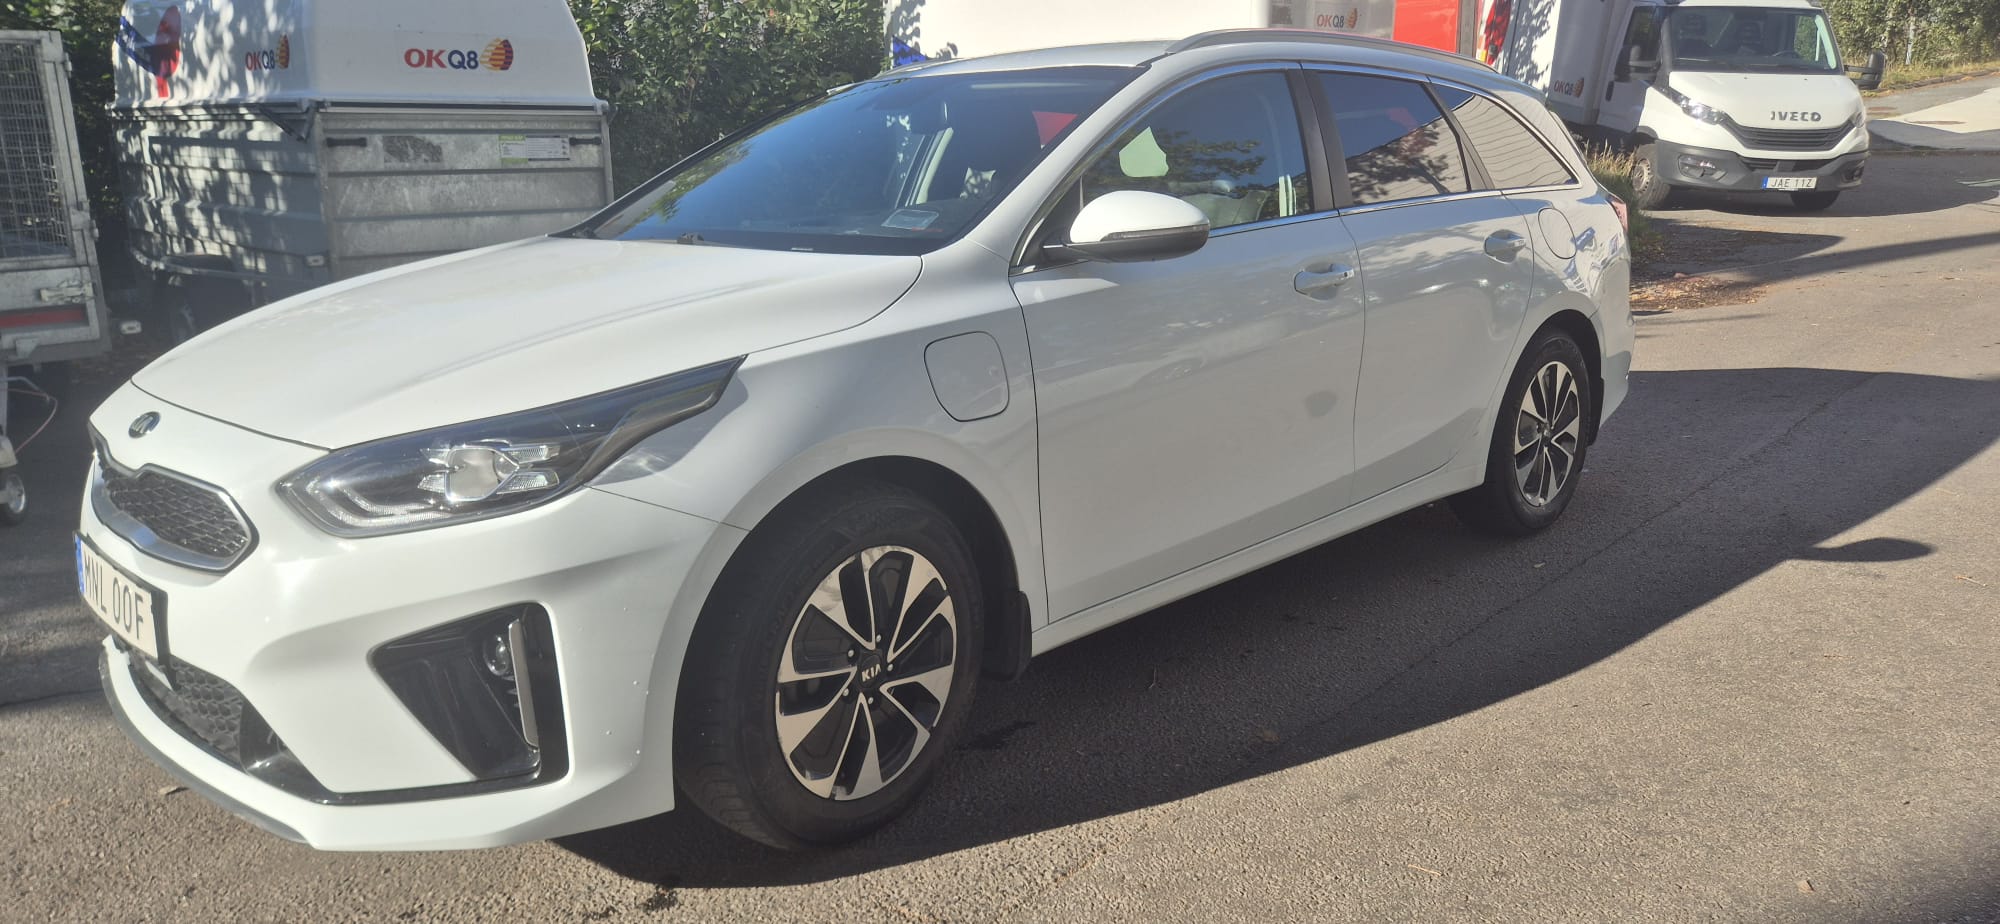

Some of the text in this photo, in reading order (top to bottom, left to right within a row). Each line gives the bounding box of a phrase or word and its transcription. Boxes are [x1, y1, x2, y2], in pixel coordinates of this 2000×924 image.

[1316, 14, 1345, 28] OKQ8
[244, 50, 275, 70] OKQ8
[404, 48, 479, 69] OKQ8
[1770, 111, 1822, 122] IVECO
[1771, 178, 1791, 188] JAE
[84, 550, 107, 614] MNL
[861, 663, 882, 682] KIA
